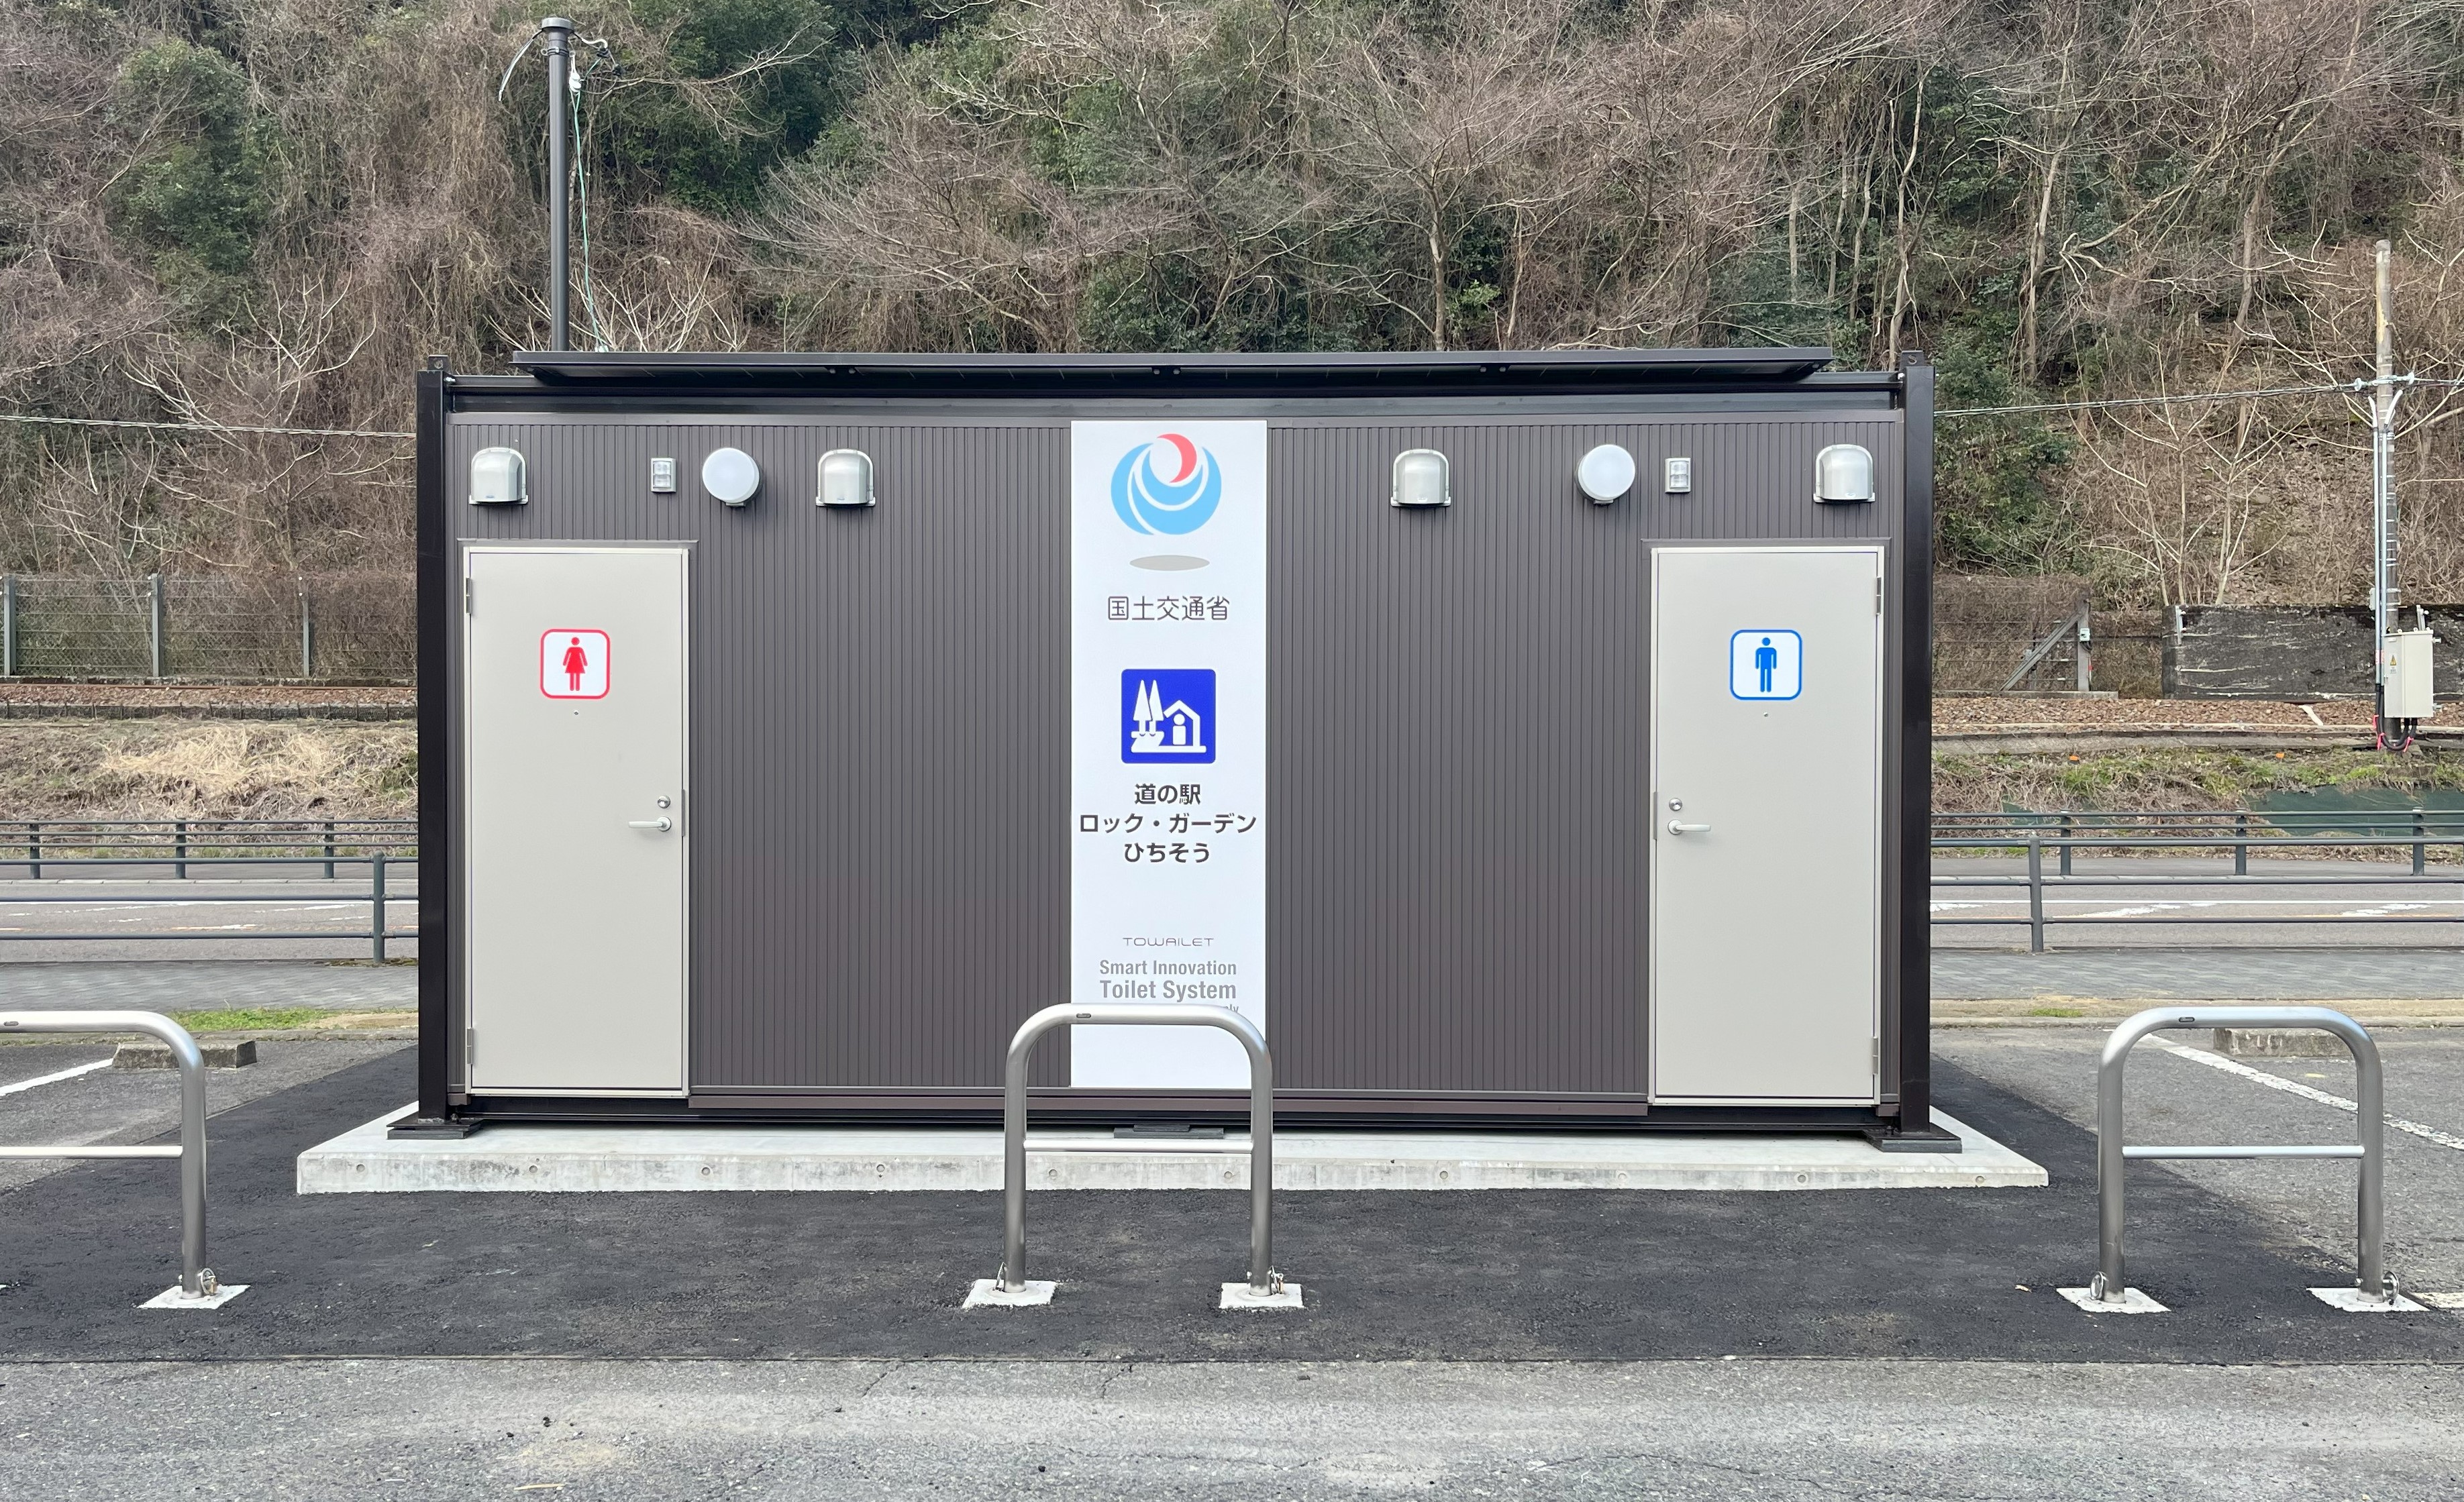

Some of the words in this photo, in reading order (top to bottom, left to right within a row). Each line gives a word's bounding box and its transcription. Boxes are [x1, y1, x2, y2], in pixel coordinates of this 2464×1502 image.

[1107, 595, 1230, 621] 国土交通省
[1134, 783, 1202, 806] 道の駅
[1080, 812, 1257, 834] ロック・ガーデン
[1124, 842, 1210, 863] ひちそう
[1122, 937, 1214, 947] TOWAILET
[1099, 959, 1147, 975] Smart
[1153, 959, 1237, 975] Innovation
[1099, 979, 1156, 999] Toilet
[1162, 979, 1237, 1003] System
